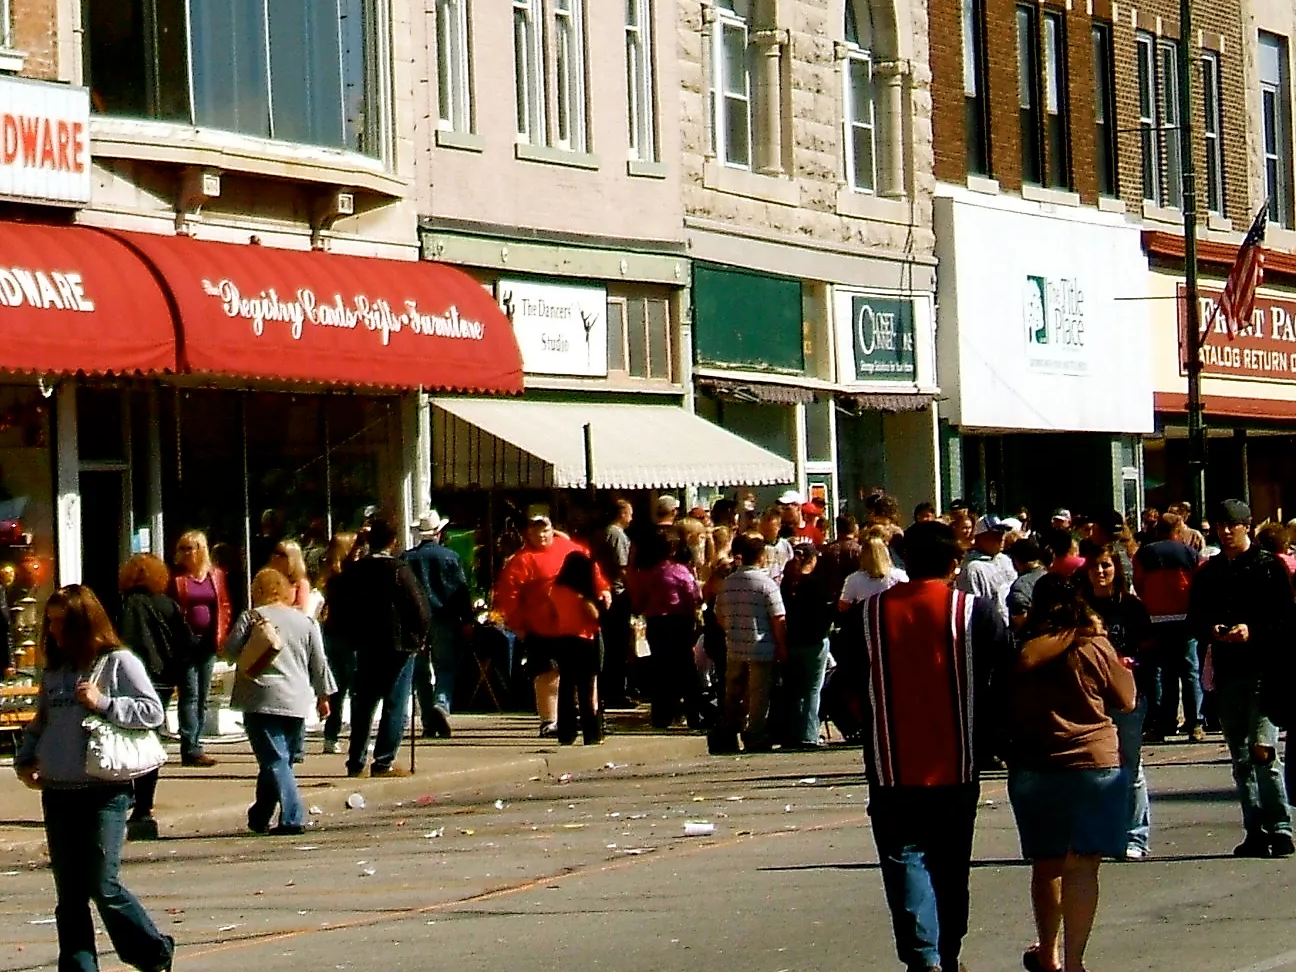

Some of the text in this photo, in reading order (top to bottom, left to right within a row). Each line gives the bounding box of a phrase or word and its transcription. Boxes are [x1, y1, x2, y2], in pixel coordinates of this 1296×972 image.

[219, 280, 304, 340] Registry
[404, 299, 485, 340] Furniture
[521, 298, 537, 317] The
[1198, 297, 1296, 342] FRT PA
[541, 332, 570, 353] Studio
[1199, 344, 1241, 368] ATALOG
[1244, 349, 1287, 372] RETURN
